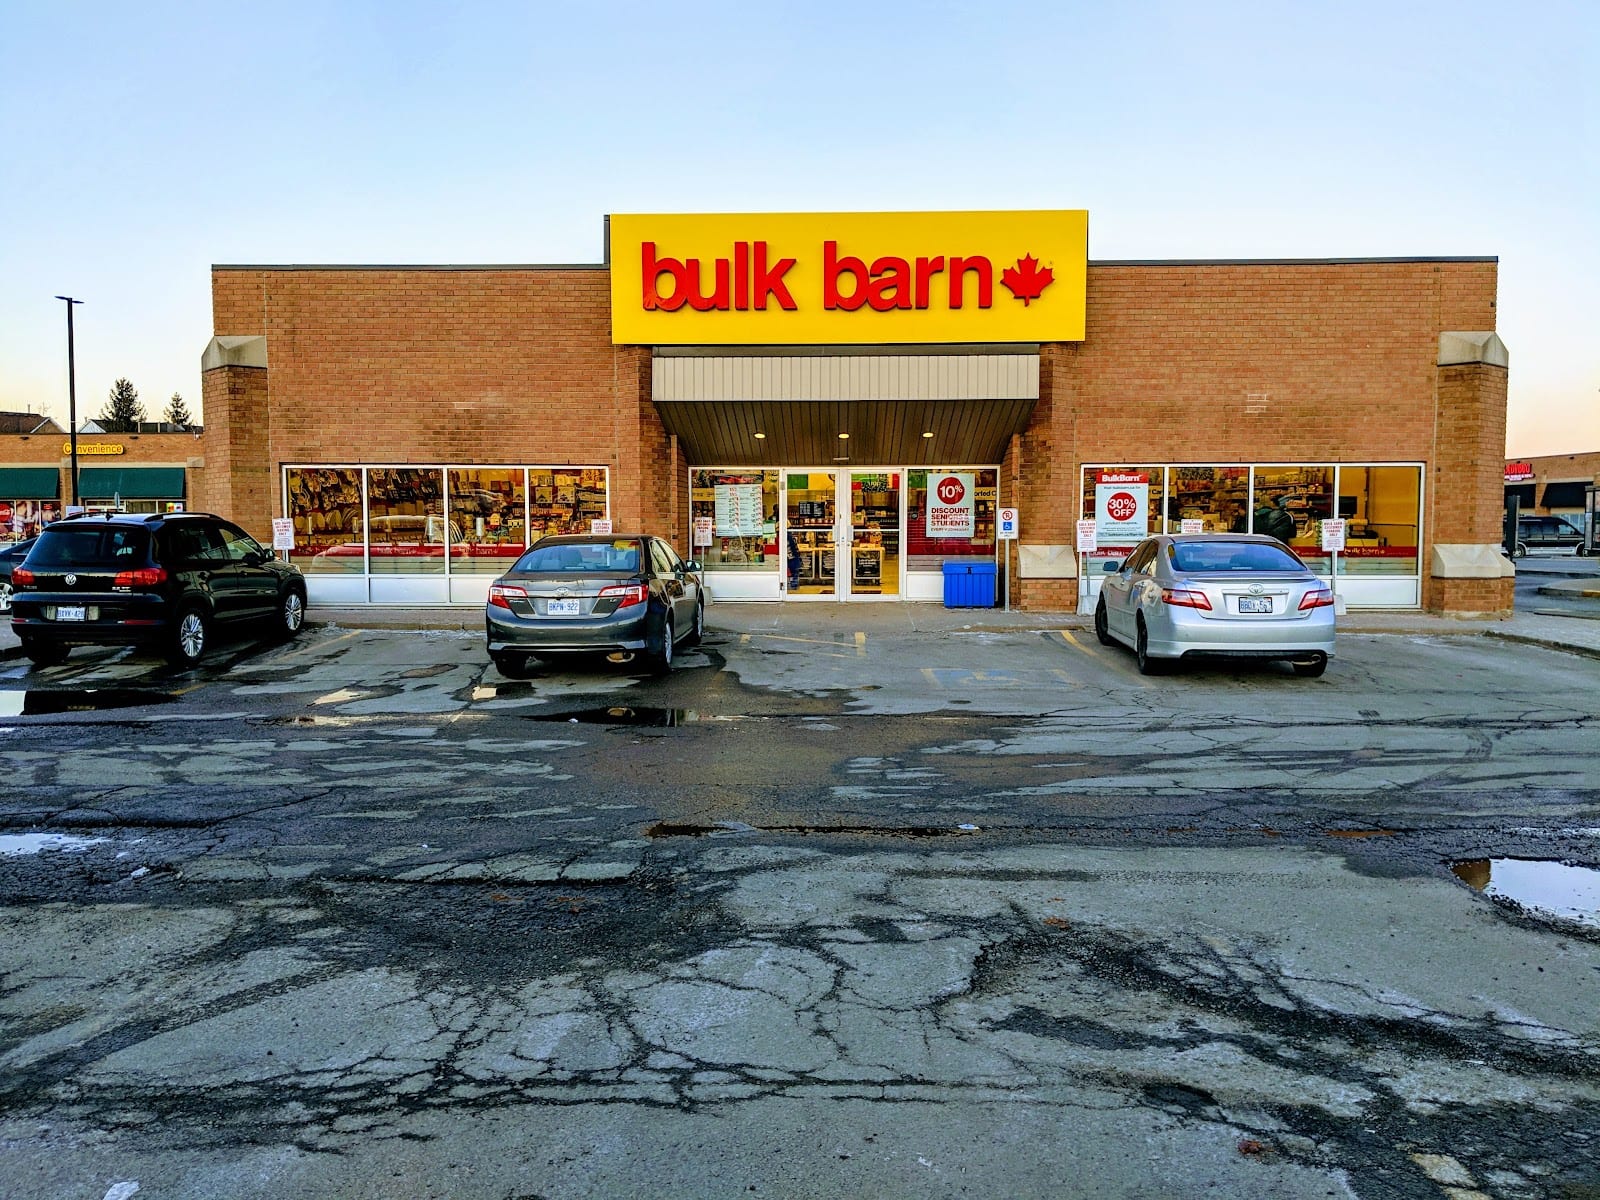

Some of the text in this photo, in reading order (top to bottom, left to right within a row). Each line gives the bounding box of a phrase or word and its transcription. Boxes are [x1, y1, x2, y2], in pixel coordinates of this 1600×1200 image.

[641, 240, 993, 312] bulk barn
[63, 443, 123, 454] Cnvenience
[940, 485, 963, 498] 10%
[1108, 498, 1136, 510] 30%
